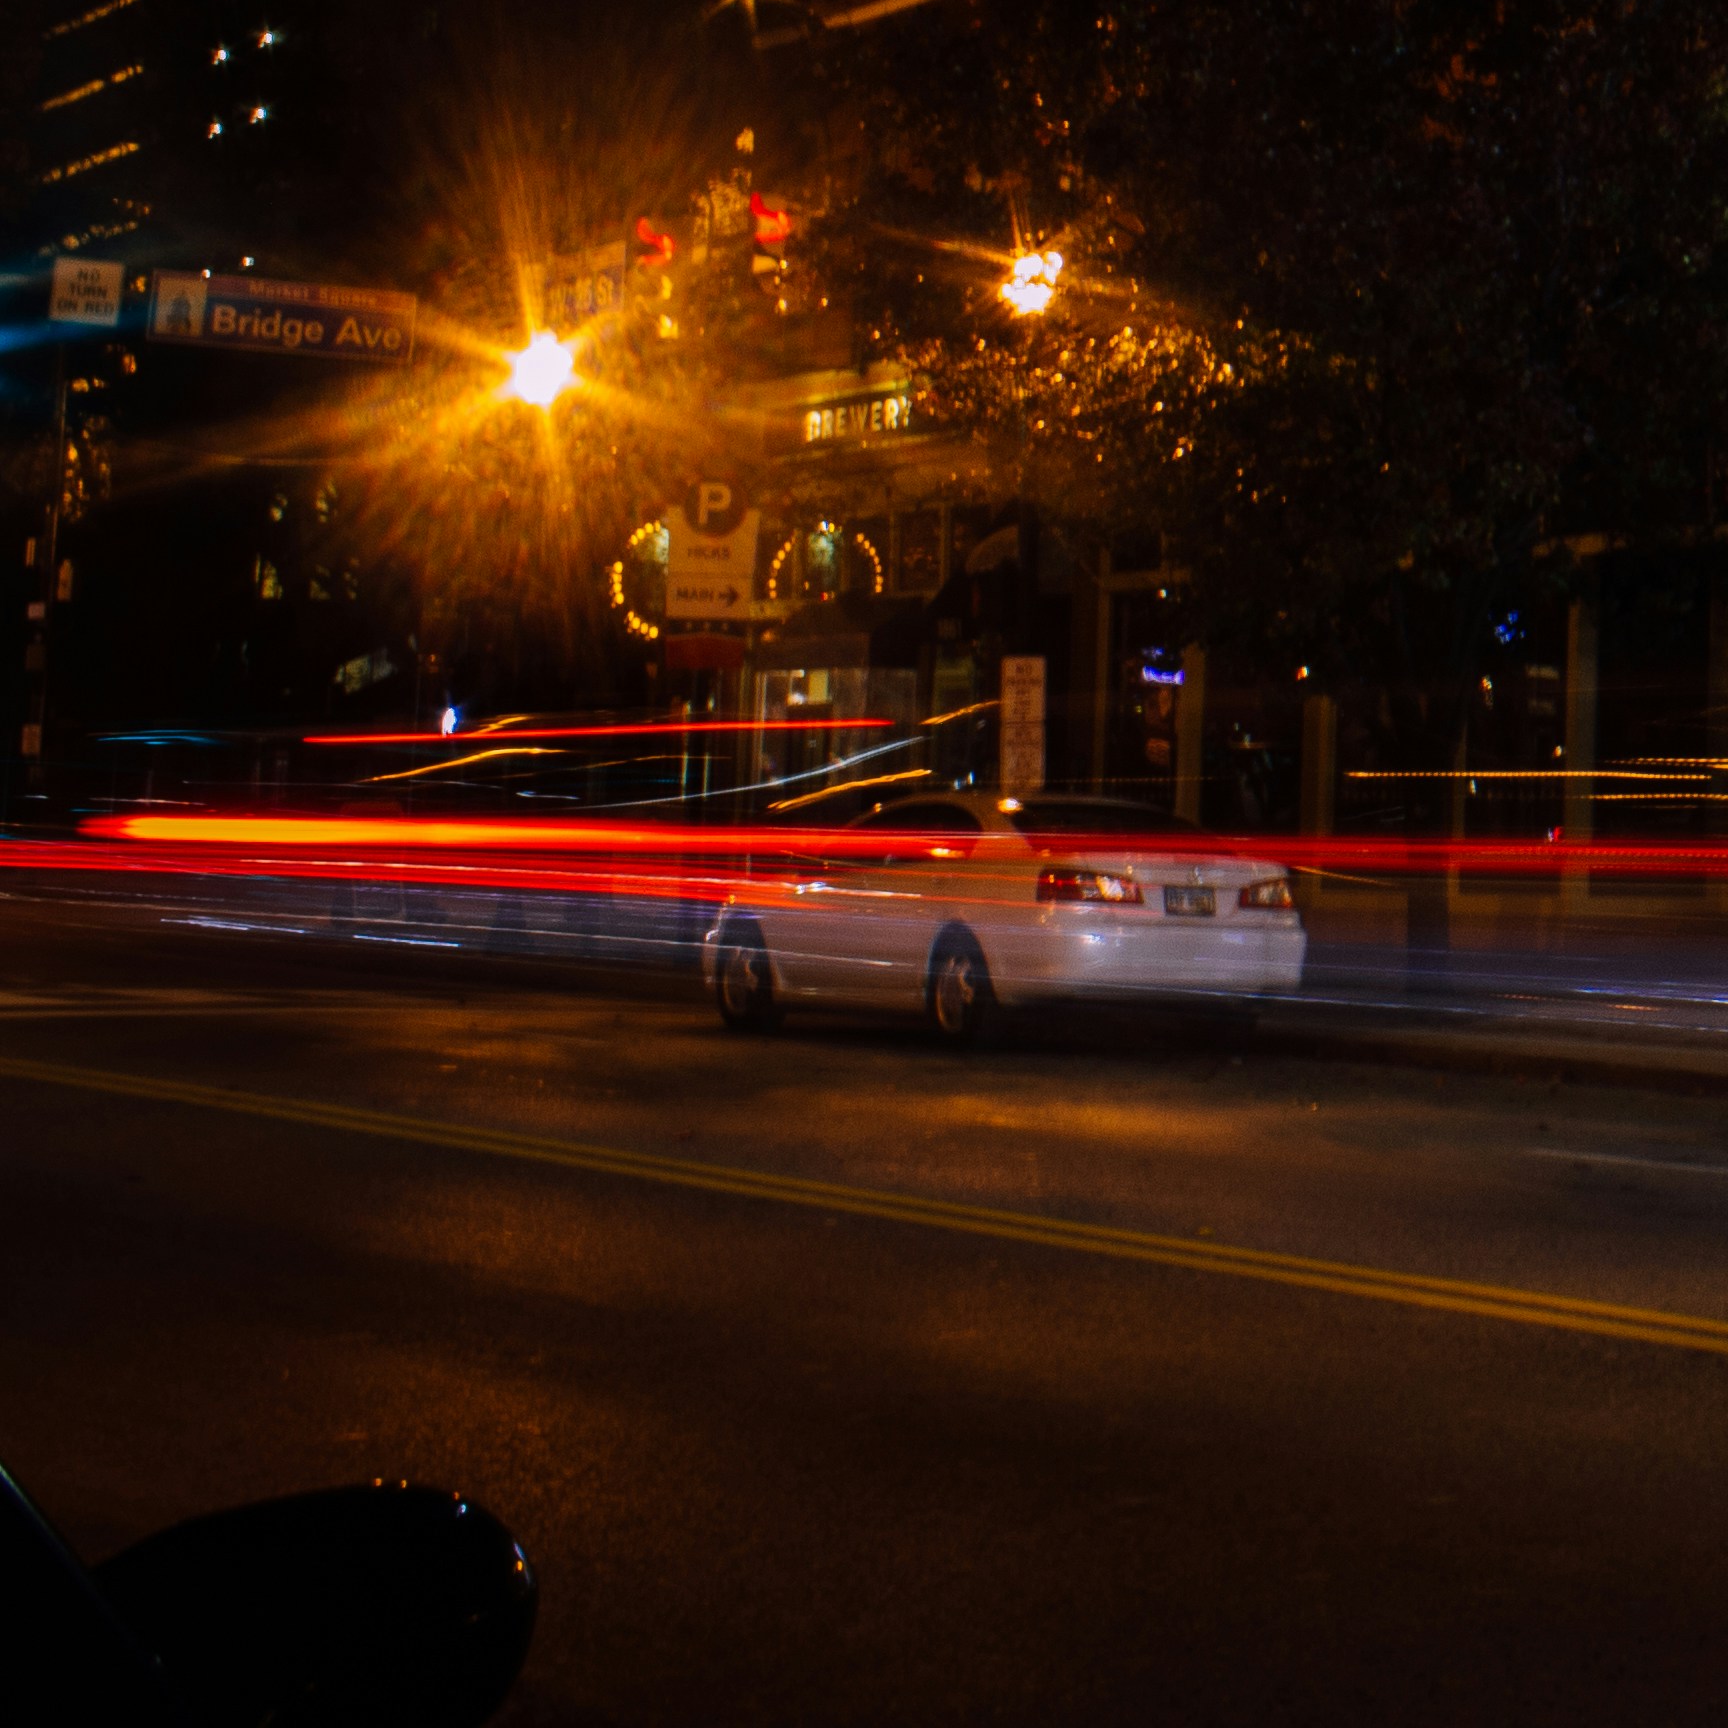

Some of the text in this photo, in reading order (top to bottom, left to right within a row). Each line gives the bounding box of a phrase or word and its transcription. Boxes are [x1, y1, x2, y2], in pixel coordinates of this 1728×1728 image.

[212, 304, 324, 348] Bridge
[803, 395, 912, 443] BREWERY
[698, 484, 731, 523] P
